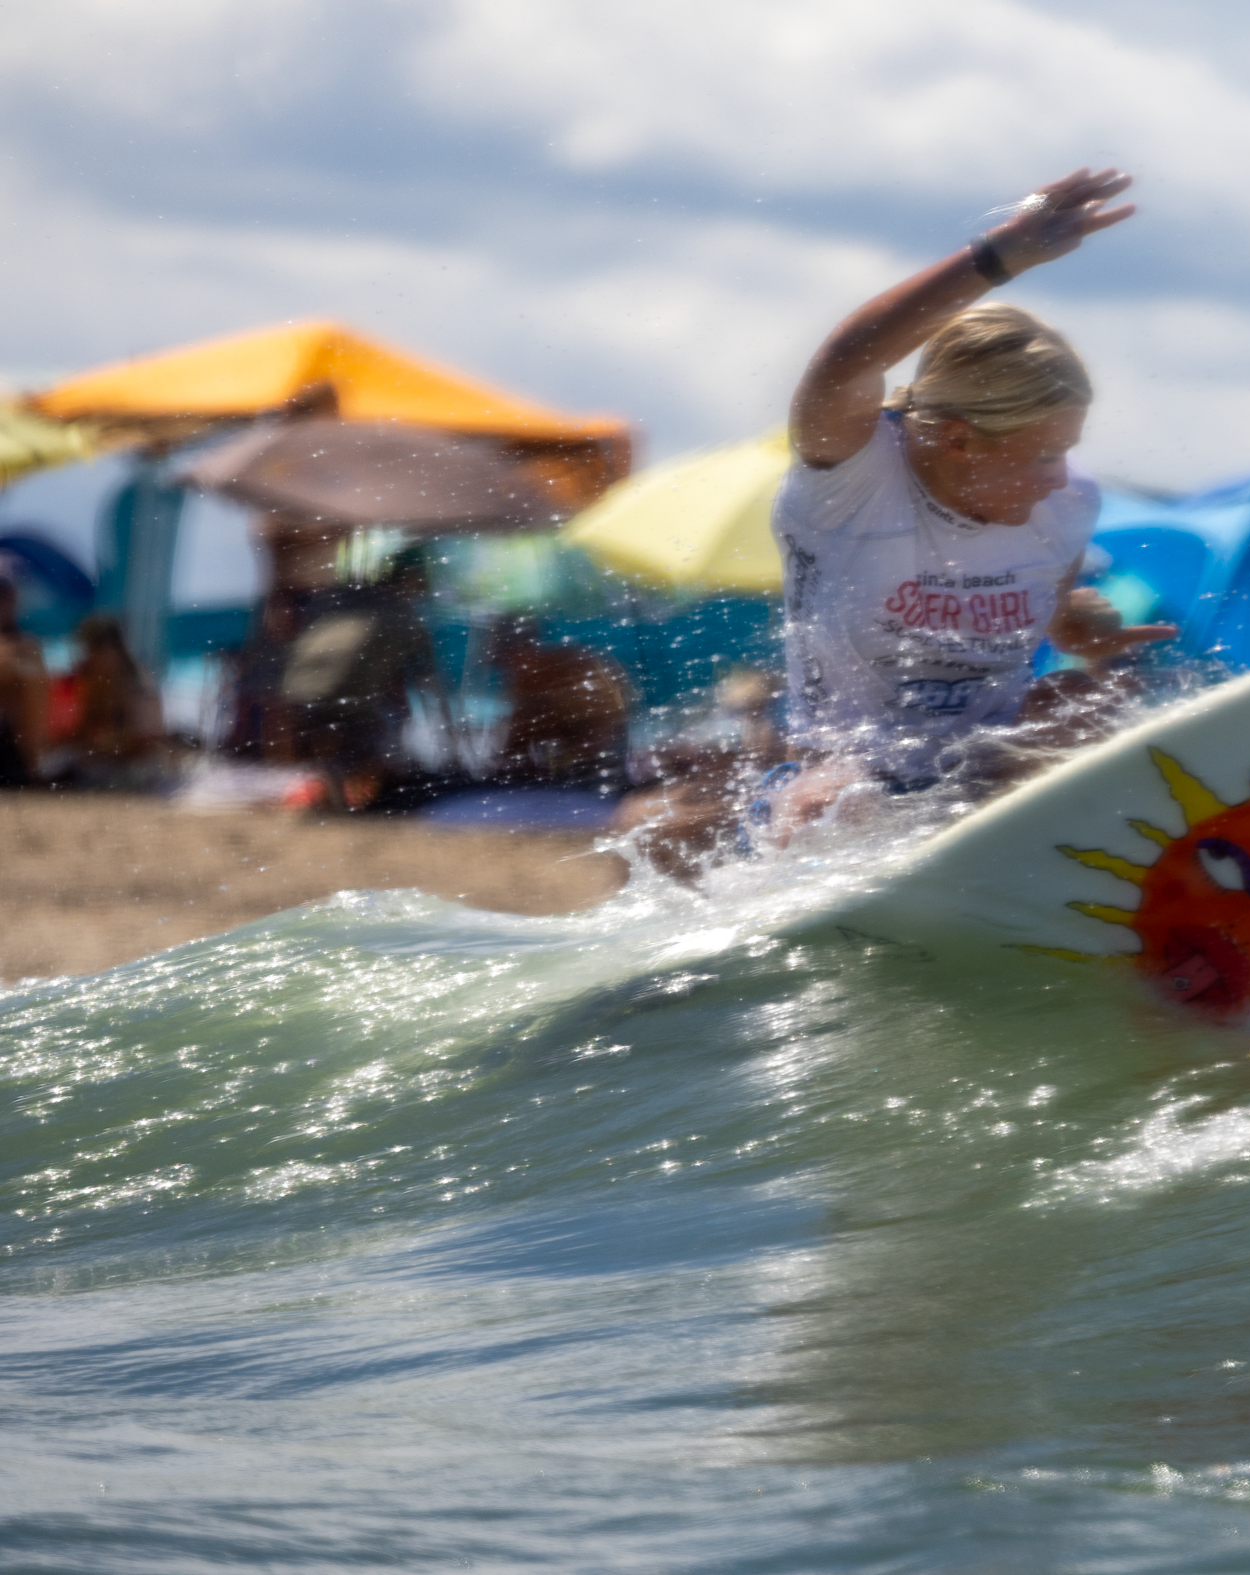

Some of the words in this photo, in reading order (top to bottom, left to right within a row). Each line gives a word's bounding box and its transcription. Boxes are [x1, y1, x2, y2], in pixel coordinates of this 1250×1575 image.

[962, 570, 1016, 590] beach
[885, 580, 962, 632] SUER
[969, 589, 1036, 635] GIRL
